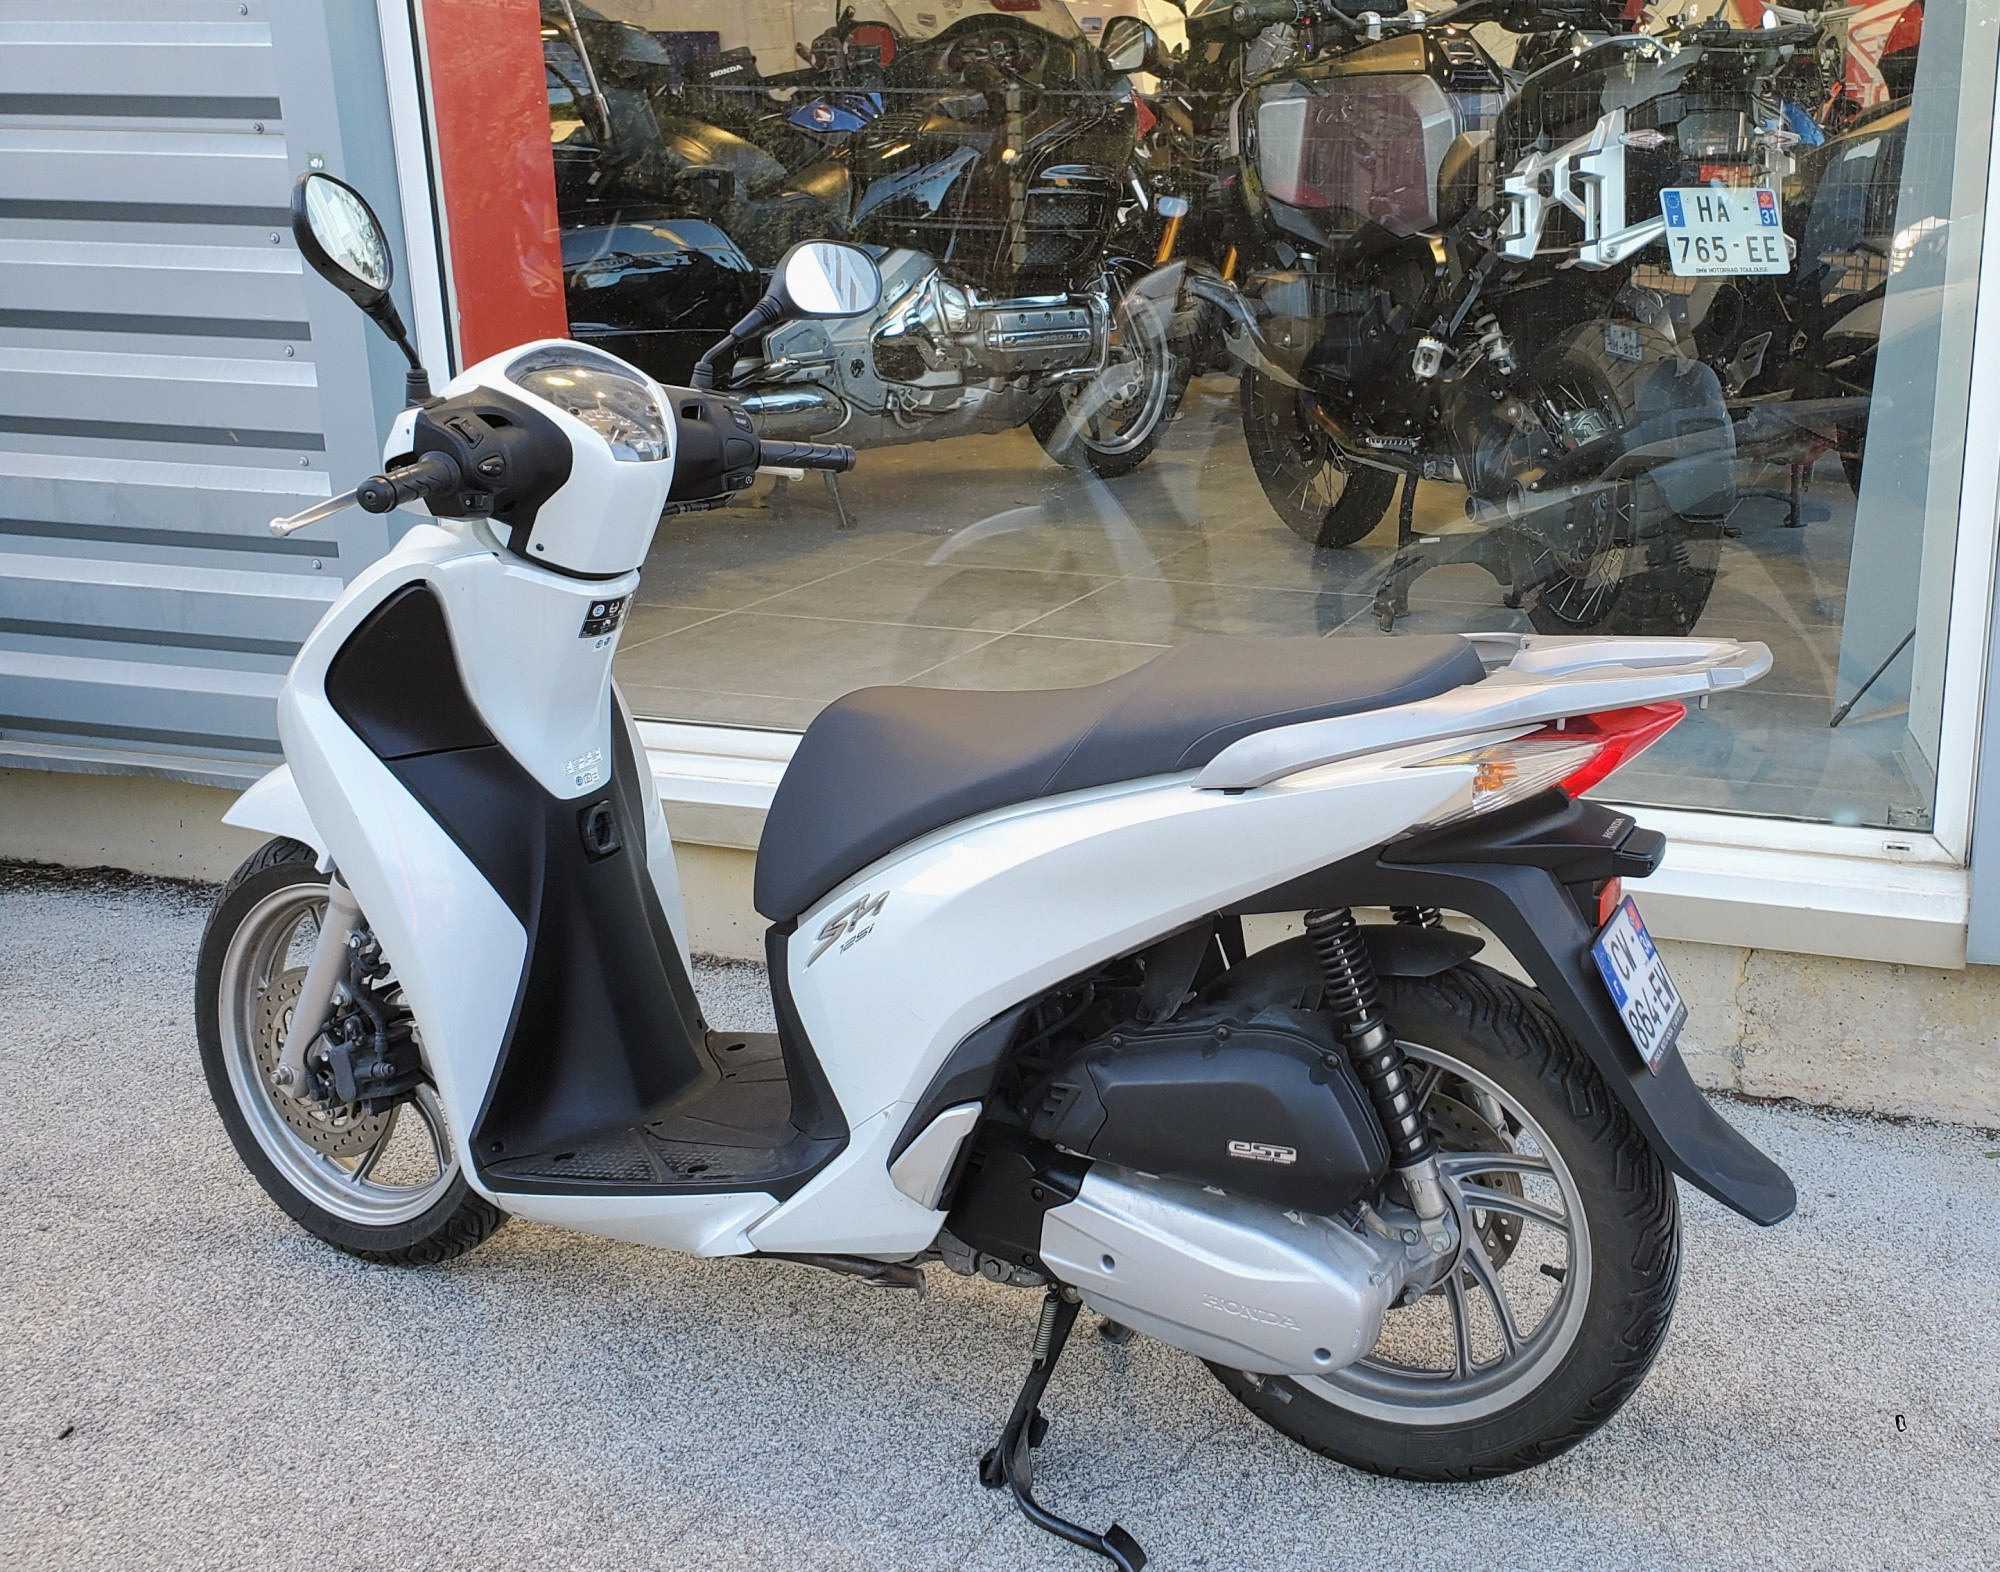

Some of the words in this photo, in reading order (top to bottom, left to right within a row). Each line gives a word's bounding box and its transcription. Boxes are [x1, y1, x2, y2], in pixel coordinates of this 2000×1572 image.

[709, 64, 744, 78] HONDA
[1672, 214, 1679, 225] F
[1761, 209, 1777, 225] 31
[1676, 236, 1780, 264] 765-EE
[1602, 818, 1626, 839] HONDA
[805, 890, 891, 969] SH
[839, 922, 875, 955] 125i
[1640, 930, 1653, 955] 34
[1613, 980, 1620, 995] F
[1628, 961, 1676, 1050] 864-EW
[1202, 1292, 1301, 1331] HONDA
